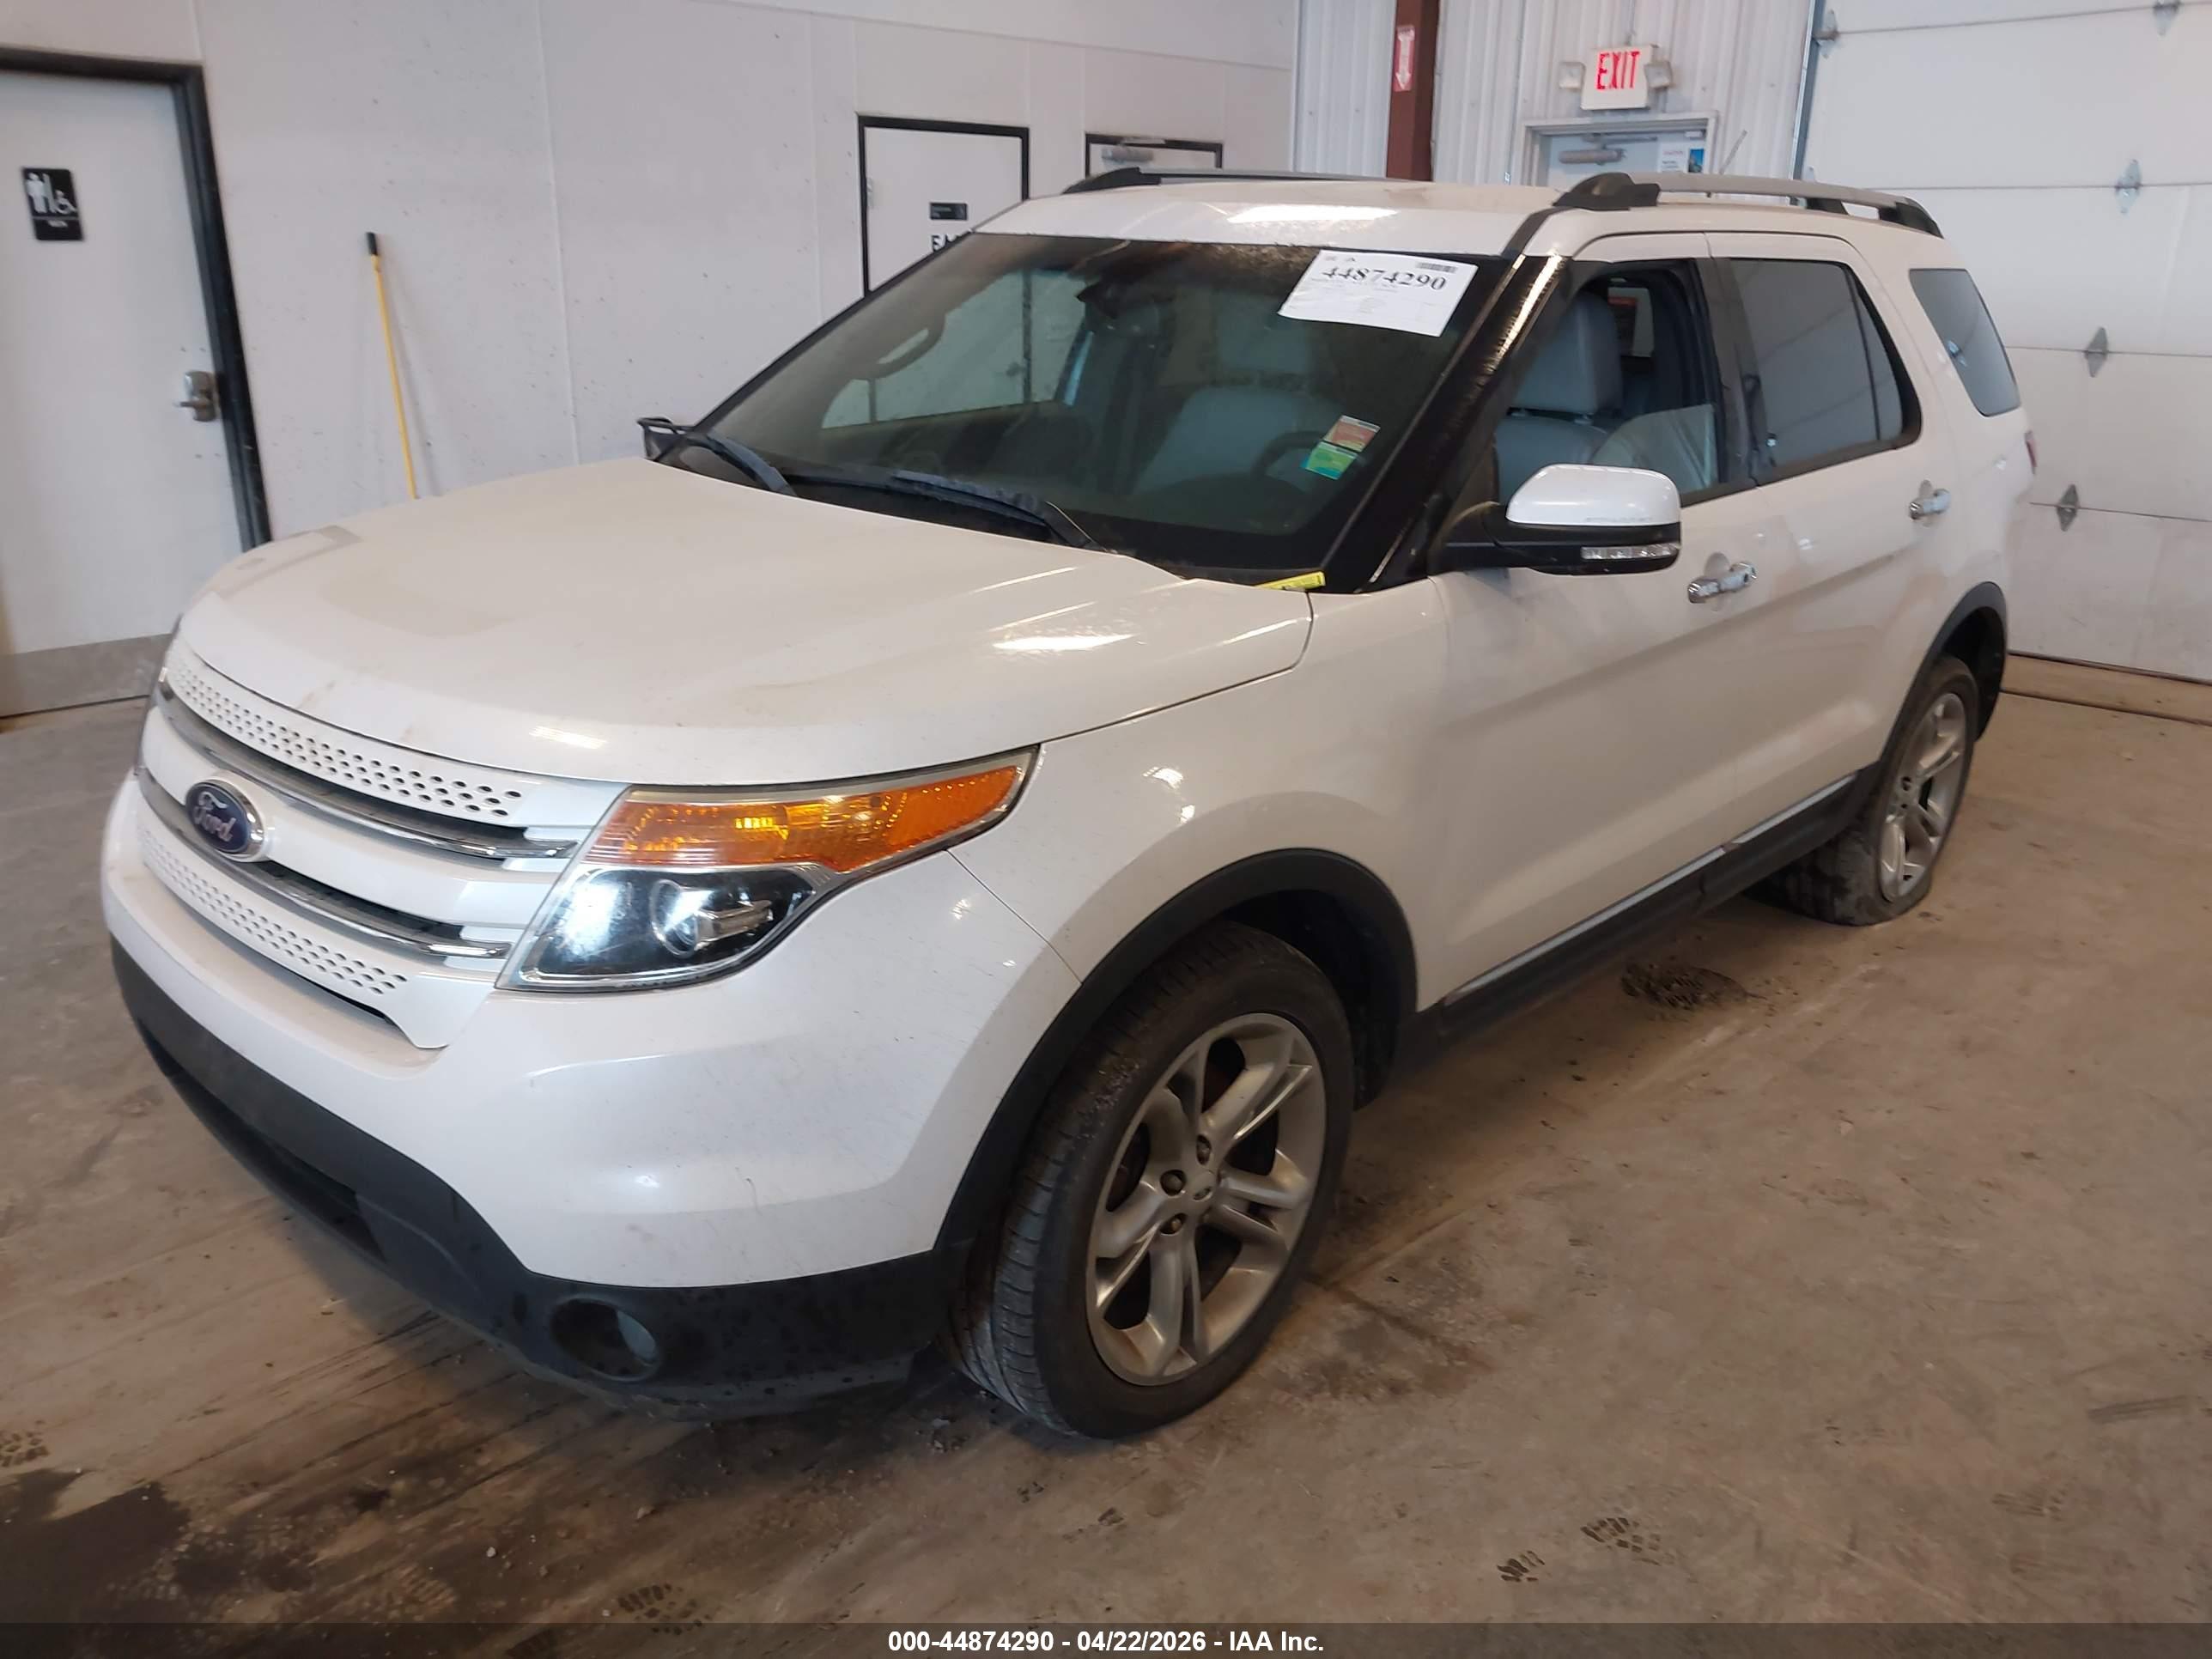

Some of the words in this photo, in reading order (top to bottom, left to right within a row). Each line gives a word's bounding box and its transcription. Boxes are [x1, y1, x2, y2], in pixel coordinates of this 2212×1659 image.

[1595, 50, 1641, 90] EXIT
[1322, 266, 1447, 290] 44874290
[192, 791, 237, 842] Ford
